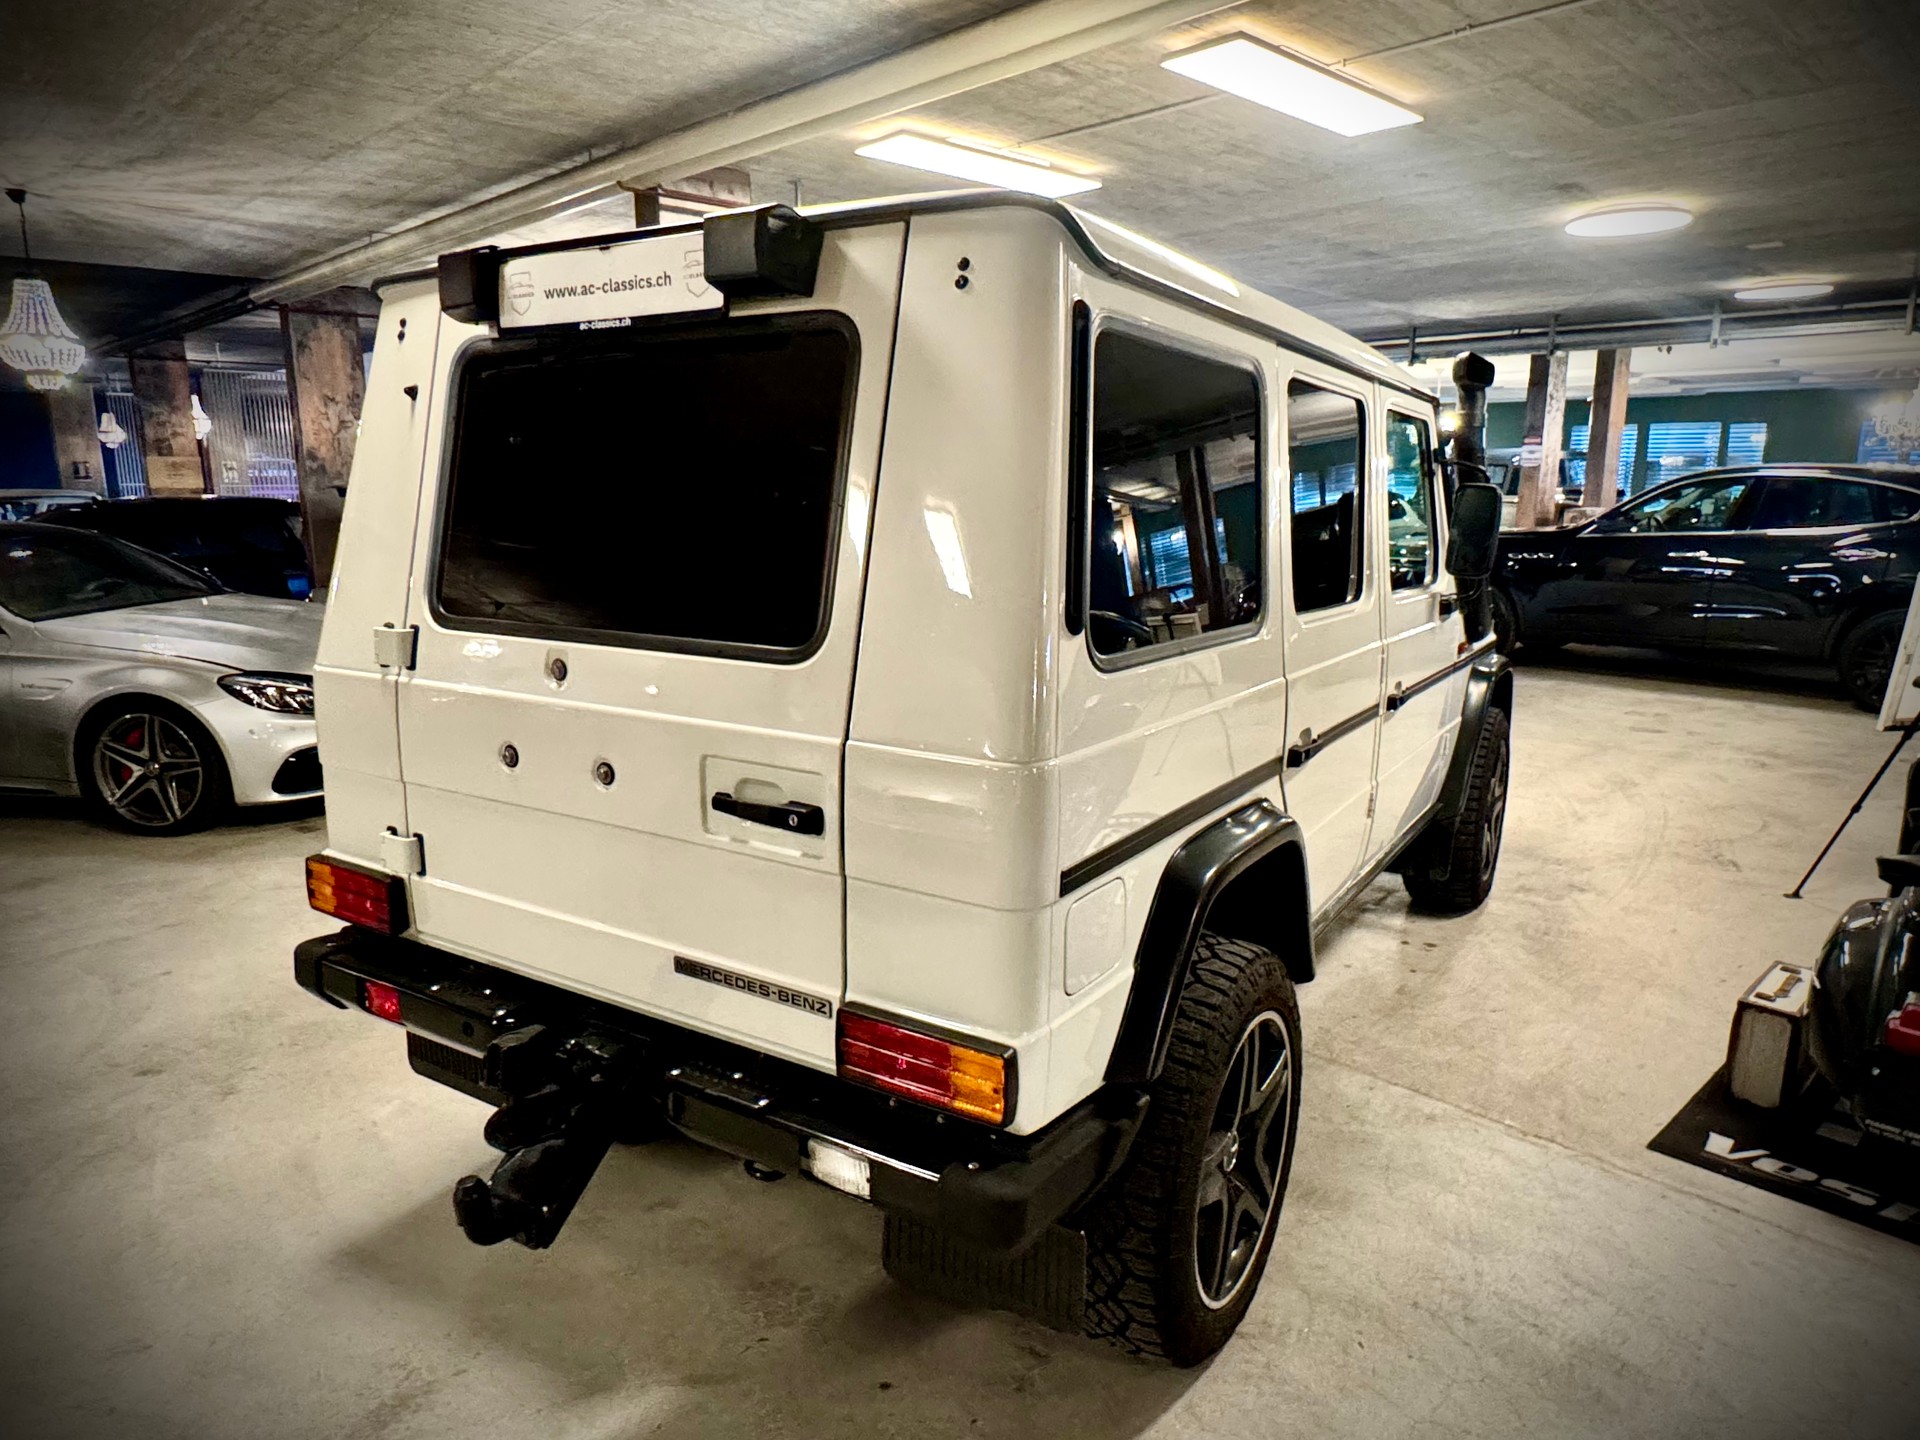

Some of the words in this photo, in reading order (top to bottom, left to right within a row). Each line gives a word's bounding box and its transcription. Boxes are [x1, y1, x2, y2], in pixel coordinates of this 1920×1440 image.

[543, 271, 672, 299] www.ac-classics.ch
[579, 317, 632, 330] ac-classics.ch
[675, 958, 828, 1015] MERCEDES-BENZ
